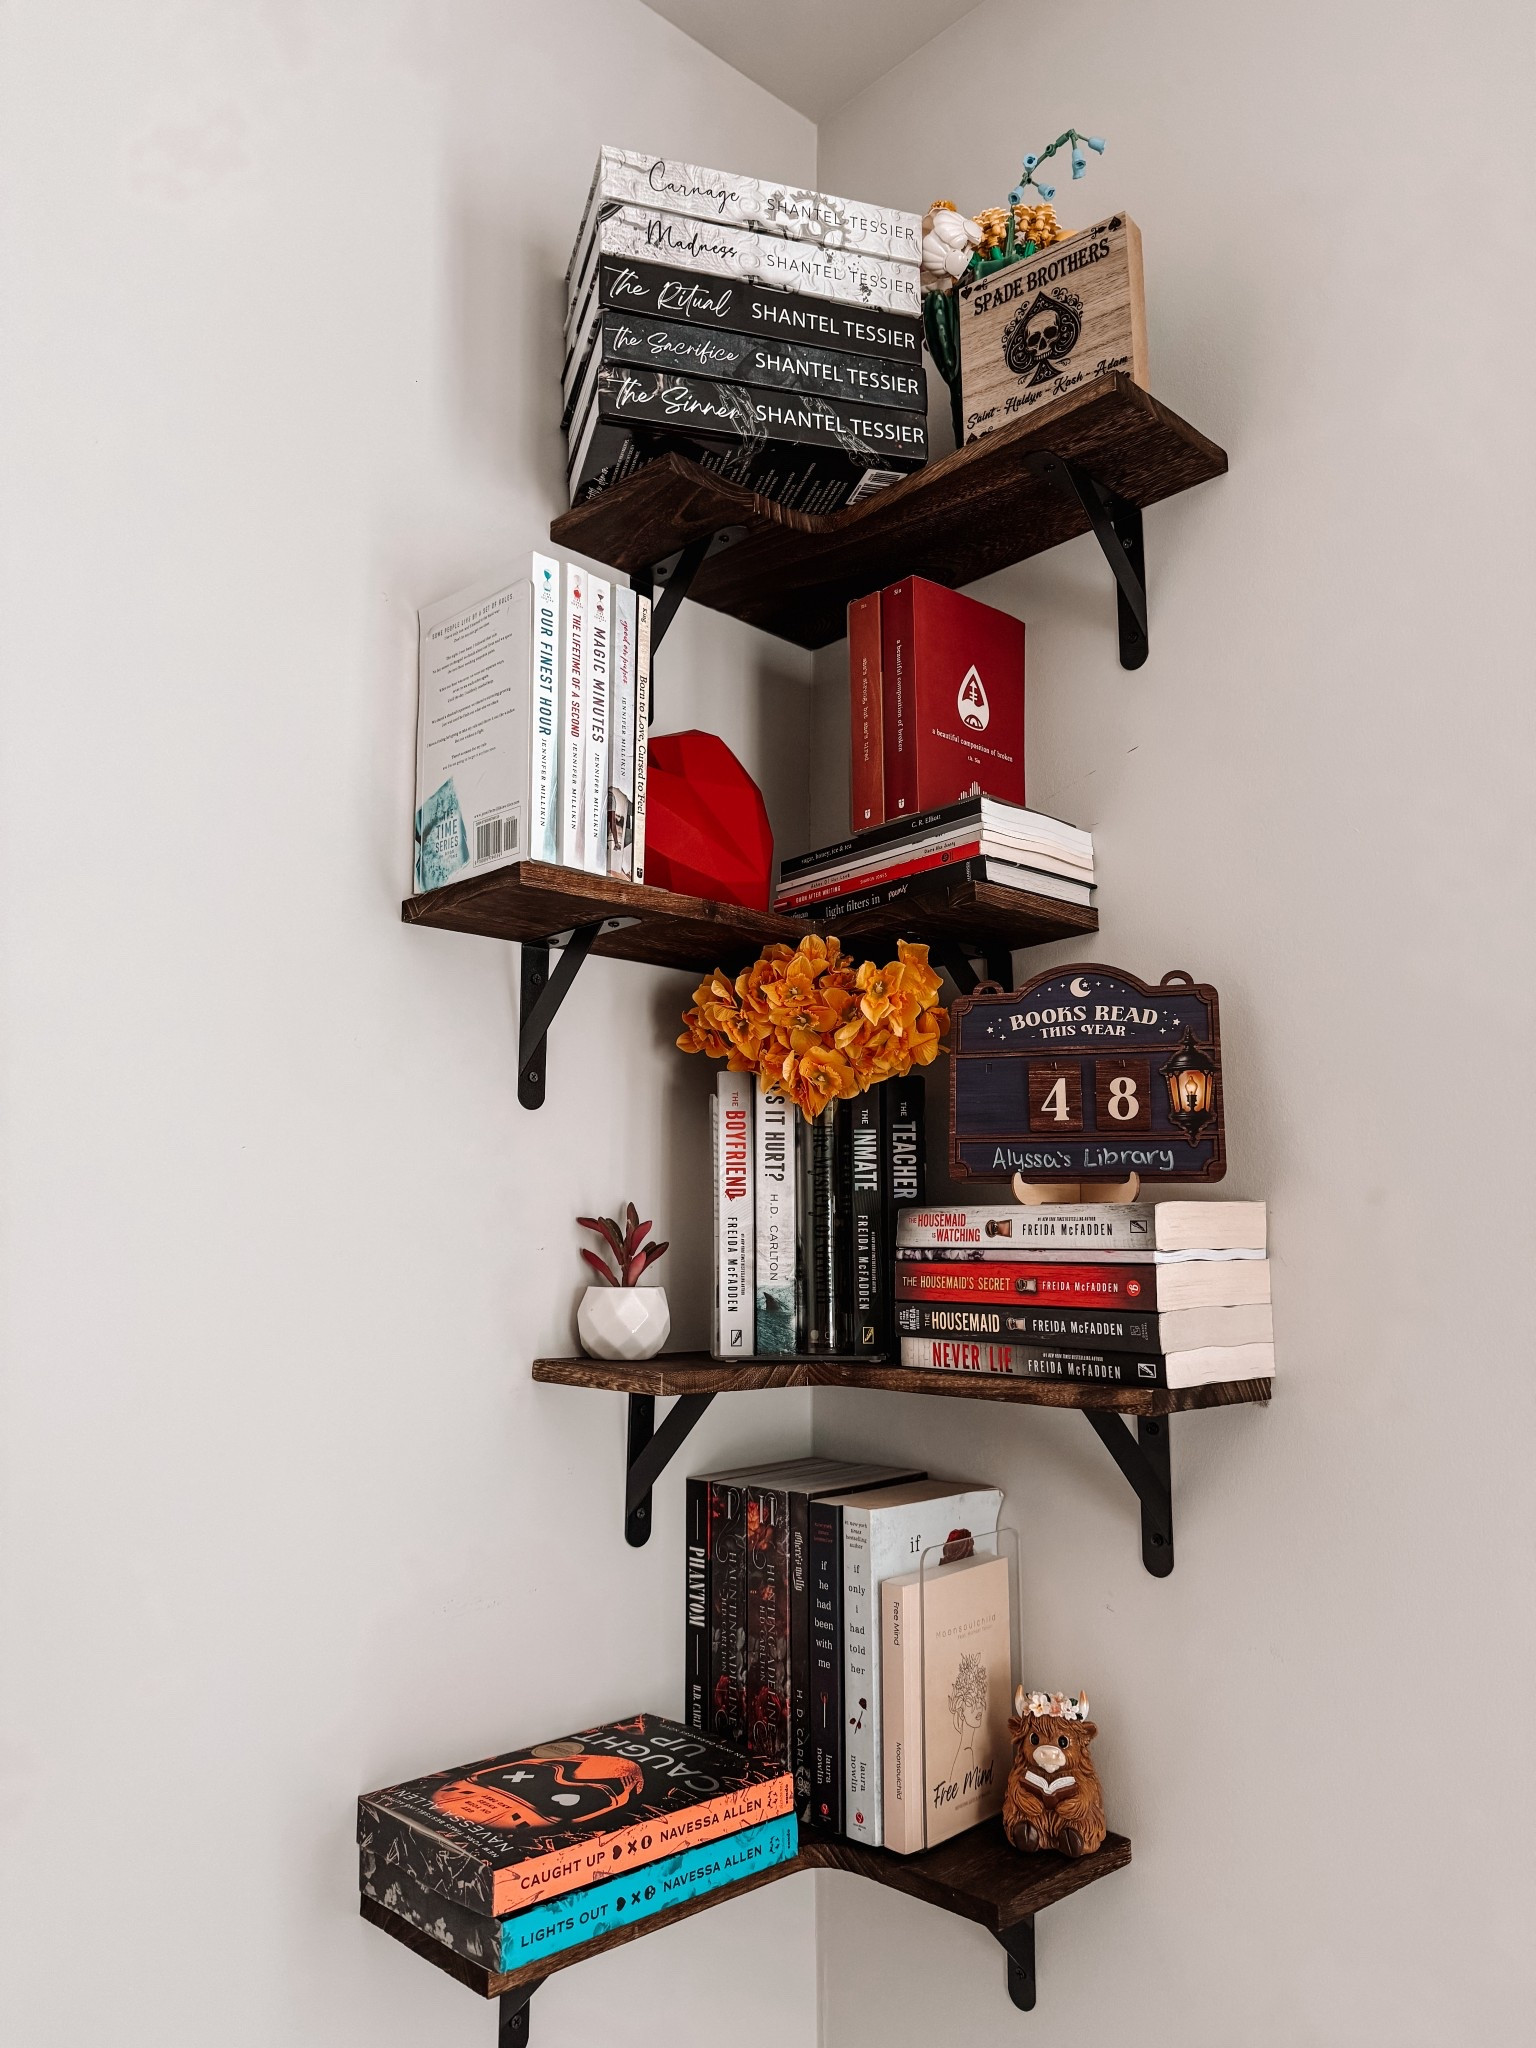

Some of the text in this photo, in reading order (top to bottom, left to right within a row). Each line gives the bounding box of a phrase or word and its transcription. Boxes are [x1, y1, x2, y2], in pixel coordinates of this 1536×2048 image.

[648, 161, 740, 213] Carnage
[766, 197, 915, 242] SHANTEL TESSIER
[644, 218, 738, 260] Madness
[766, 254, 915, 296] SHANTEL TESSIER
[973, 239, 1110, 316] SPADE BROTHERS
[657, 279, 731, 319] Ritual
[751, 302, 916, 350] SHANTEL TESSIER
[646, 330, 740, 364] Sacrifice
[755, 352, 919, 396] SHANTEL TESSIER
[660, 386, 745, 421] Sinner
[966, 408, 996, 431] Saint
[1053, 374, 1084, 396] Kash
[1094, 355, 1129, 378] Adam
[755, 405, 925, 446] SHANTEL TESSIER
[572, 613, 582, 632] THE
[572, 633, 581, 677] LIFETIME
[539, 608, 554, 736] OUR FINEST HOUR
[571, 677, 581, 691] OF
[592, 627, 606, 744] MAGIC MINUTES
[570, 700, 580, 738] SECOND
[637, 675, 648, 816] Born to Love, Cursed to Feel
[936, 728, 960, 743] beautiful
[960, 738, 990, 754] composition
[990, 749, 997, 757] of
[996, 750, 1014, 763] broken
[435, 819, 458, 840] TIME
[925, 814, 942, 824] Elliott
[435, 836, 459, 854] SERIES
[808, 890, 822, 900] AFTER
[822, 885, 841, 897] WRITING
[825, 893, 880, 920] light filters in
[1009, 1005, 1159, 1031] BOOKS READ
[1040, 1024, 1126, 1039] THIS YEAR
[1040, 1076, 1140, 1122] 4 8
[765, 1111, 786, 1126] IT
[725, 1091, 747, 1199] THE BOYFRIEND
[764, 1131, 786, 1182] HURT?
[853, 1108, 878, 1192] THE INMATE
[892, 1101, 918, 1199] THE TEACHER
[992, 1146, 1175, 1173] Alyssa's Library
[917, 1213, 966, 1228] HOUSEMAID
[936, 1228, 981, 1243] WATCHING
[1022, 1223, 1113, 1236] FREIDA McFADDEN
[769, 1194, 779, 1281] H.D. CARLTON
[727, 1216, 739, 1313] FREIDA McFADDEN
[857, 1215, 870, 1310] FREIDA McFADDEN
[902, 1275, 1011, 1291] THE HOUSEMAID'S SECRET
[1042, 1281, 1119, 1293] FREIDA McFADDEN
[931, 1311, 1000, 1333] HOUSEMAID
[1032, 1319, 1067, 1333] FREIDA
[1070, 1321, 1124, 1337] McFADDEN
[932, 1341, 1013, 1374] NEVER LIE
[1028, 1359, 1121, 1380] FREIDA McFADDEN
[909, 1534, 921, 1554] if
[820, 1560, 828, 1571] if
[853, 1564, 860, 1574] if
[689, 1546, 706, 1628] PHANTOM
[818, 1579, 829, 1591] he
[848, 1584, 866, 1597] only
[816, 1598, 832, 1611] had
[728, 1552, 738, 1727] HAUNTING ADELINE
[814, 1617, 834, 1631] been
[849, 1623, 865, 1635] had
[936, 1614, 997, 1639] Moonsoulchild
[759, 1629, 767, 1682] CARLTON
[766, 1564, 777, 1732] HUNTING ADELINE
[815, 1638, 833, 1651] with
[849, 1643, 866, 1656] told
[818, 1658, 831, 1669] me
[850, 1663, 866, 1676] her
[650, 1736, 707, 1759] UP
[796, 1689, 805, 1798] H. D. CARLTON
[571, 1732, 720, 1792] CAUGHT
[825, 1753, 833, 1784] laura
[933, 1780, 959, 1809] Free
[963, 1759, 994, 1795] Mind
[393, 1788, 514, 1852] NAVESSA ALLEN
[445, 1823, 465, 1837] TIMES
[660, 1798, 762, 1843] NAVESSA ALLEN
[464, 1835, 483, 1848] YORK
[482, 1847, 500, 1858] NEW
[520, 1851, 605, 1889] CAUGHT UP
[663, 1845, 763, 1893] NAVESSA ALLEN
[521, 1904, 609, 1948] LIGHTS OUT
